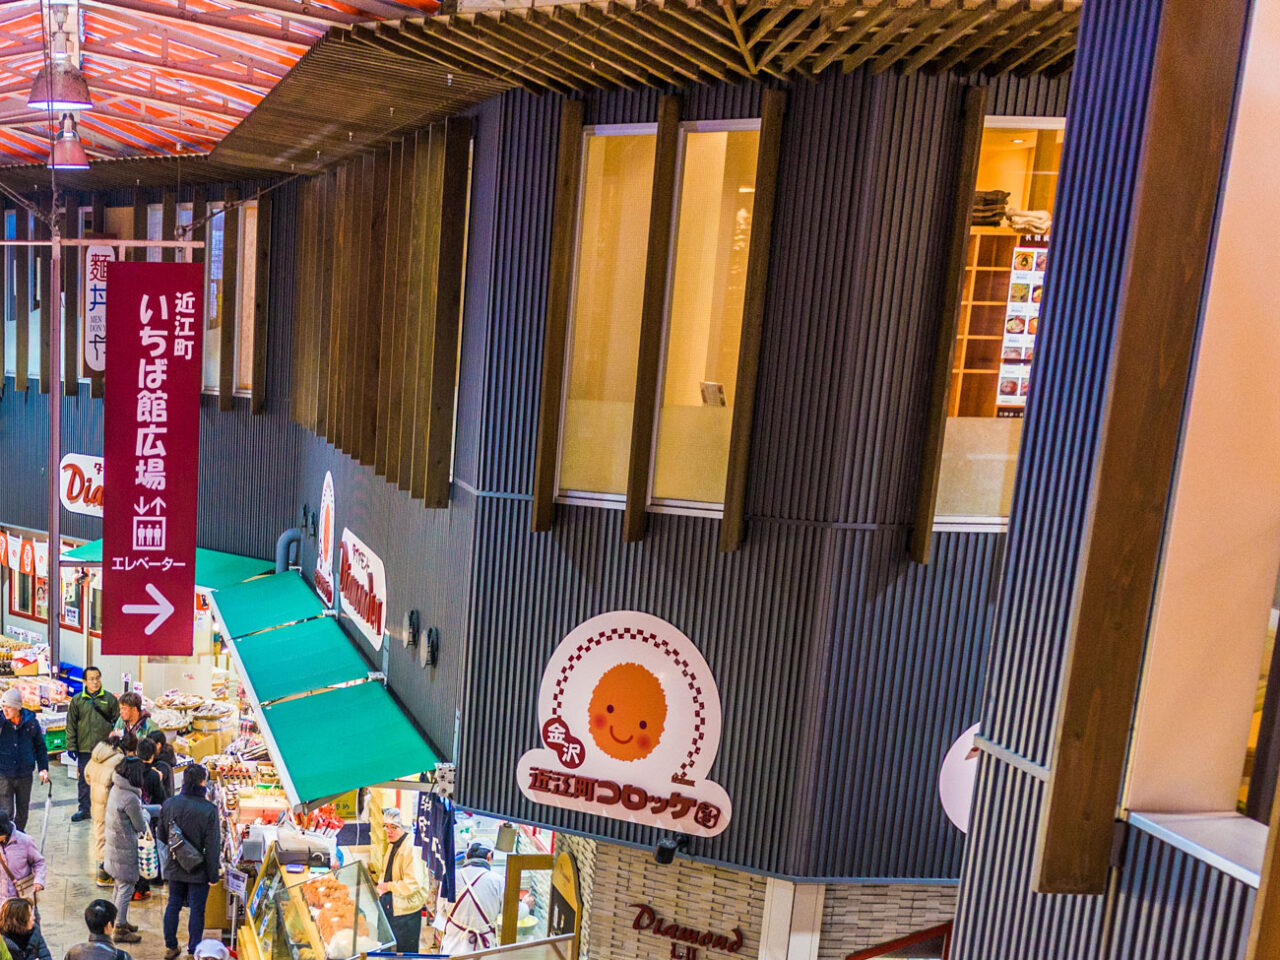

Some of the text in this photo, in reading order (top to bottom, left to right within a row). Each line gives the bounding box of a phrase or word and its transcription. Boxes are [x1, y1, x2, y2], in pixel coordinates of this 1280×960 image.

[174, 292, 195, 360] 近江町
[136, 294, 167, 490] いちば館広場
[62, 463, 104, 507] Dia
[112, 556, 185, 571] エレベーター
[547, 723, 580, 764] 金沢
[528, 767, 697, 819] 近江町コロッケ
[628, 903, 743, 953] Diamond
